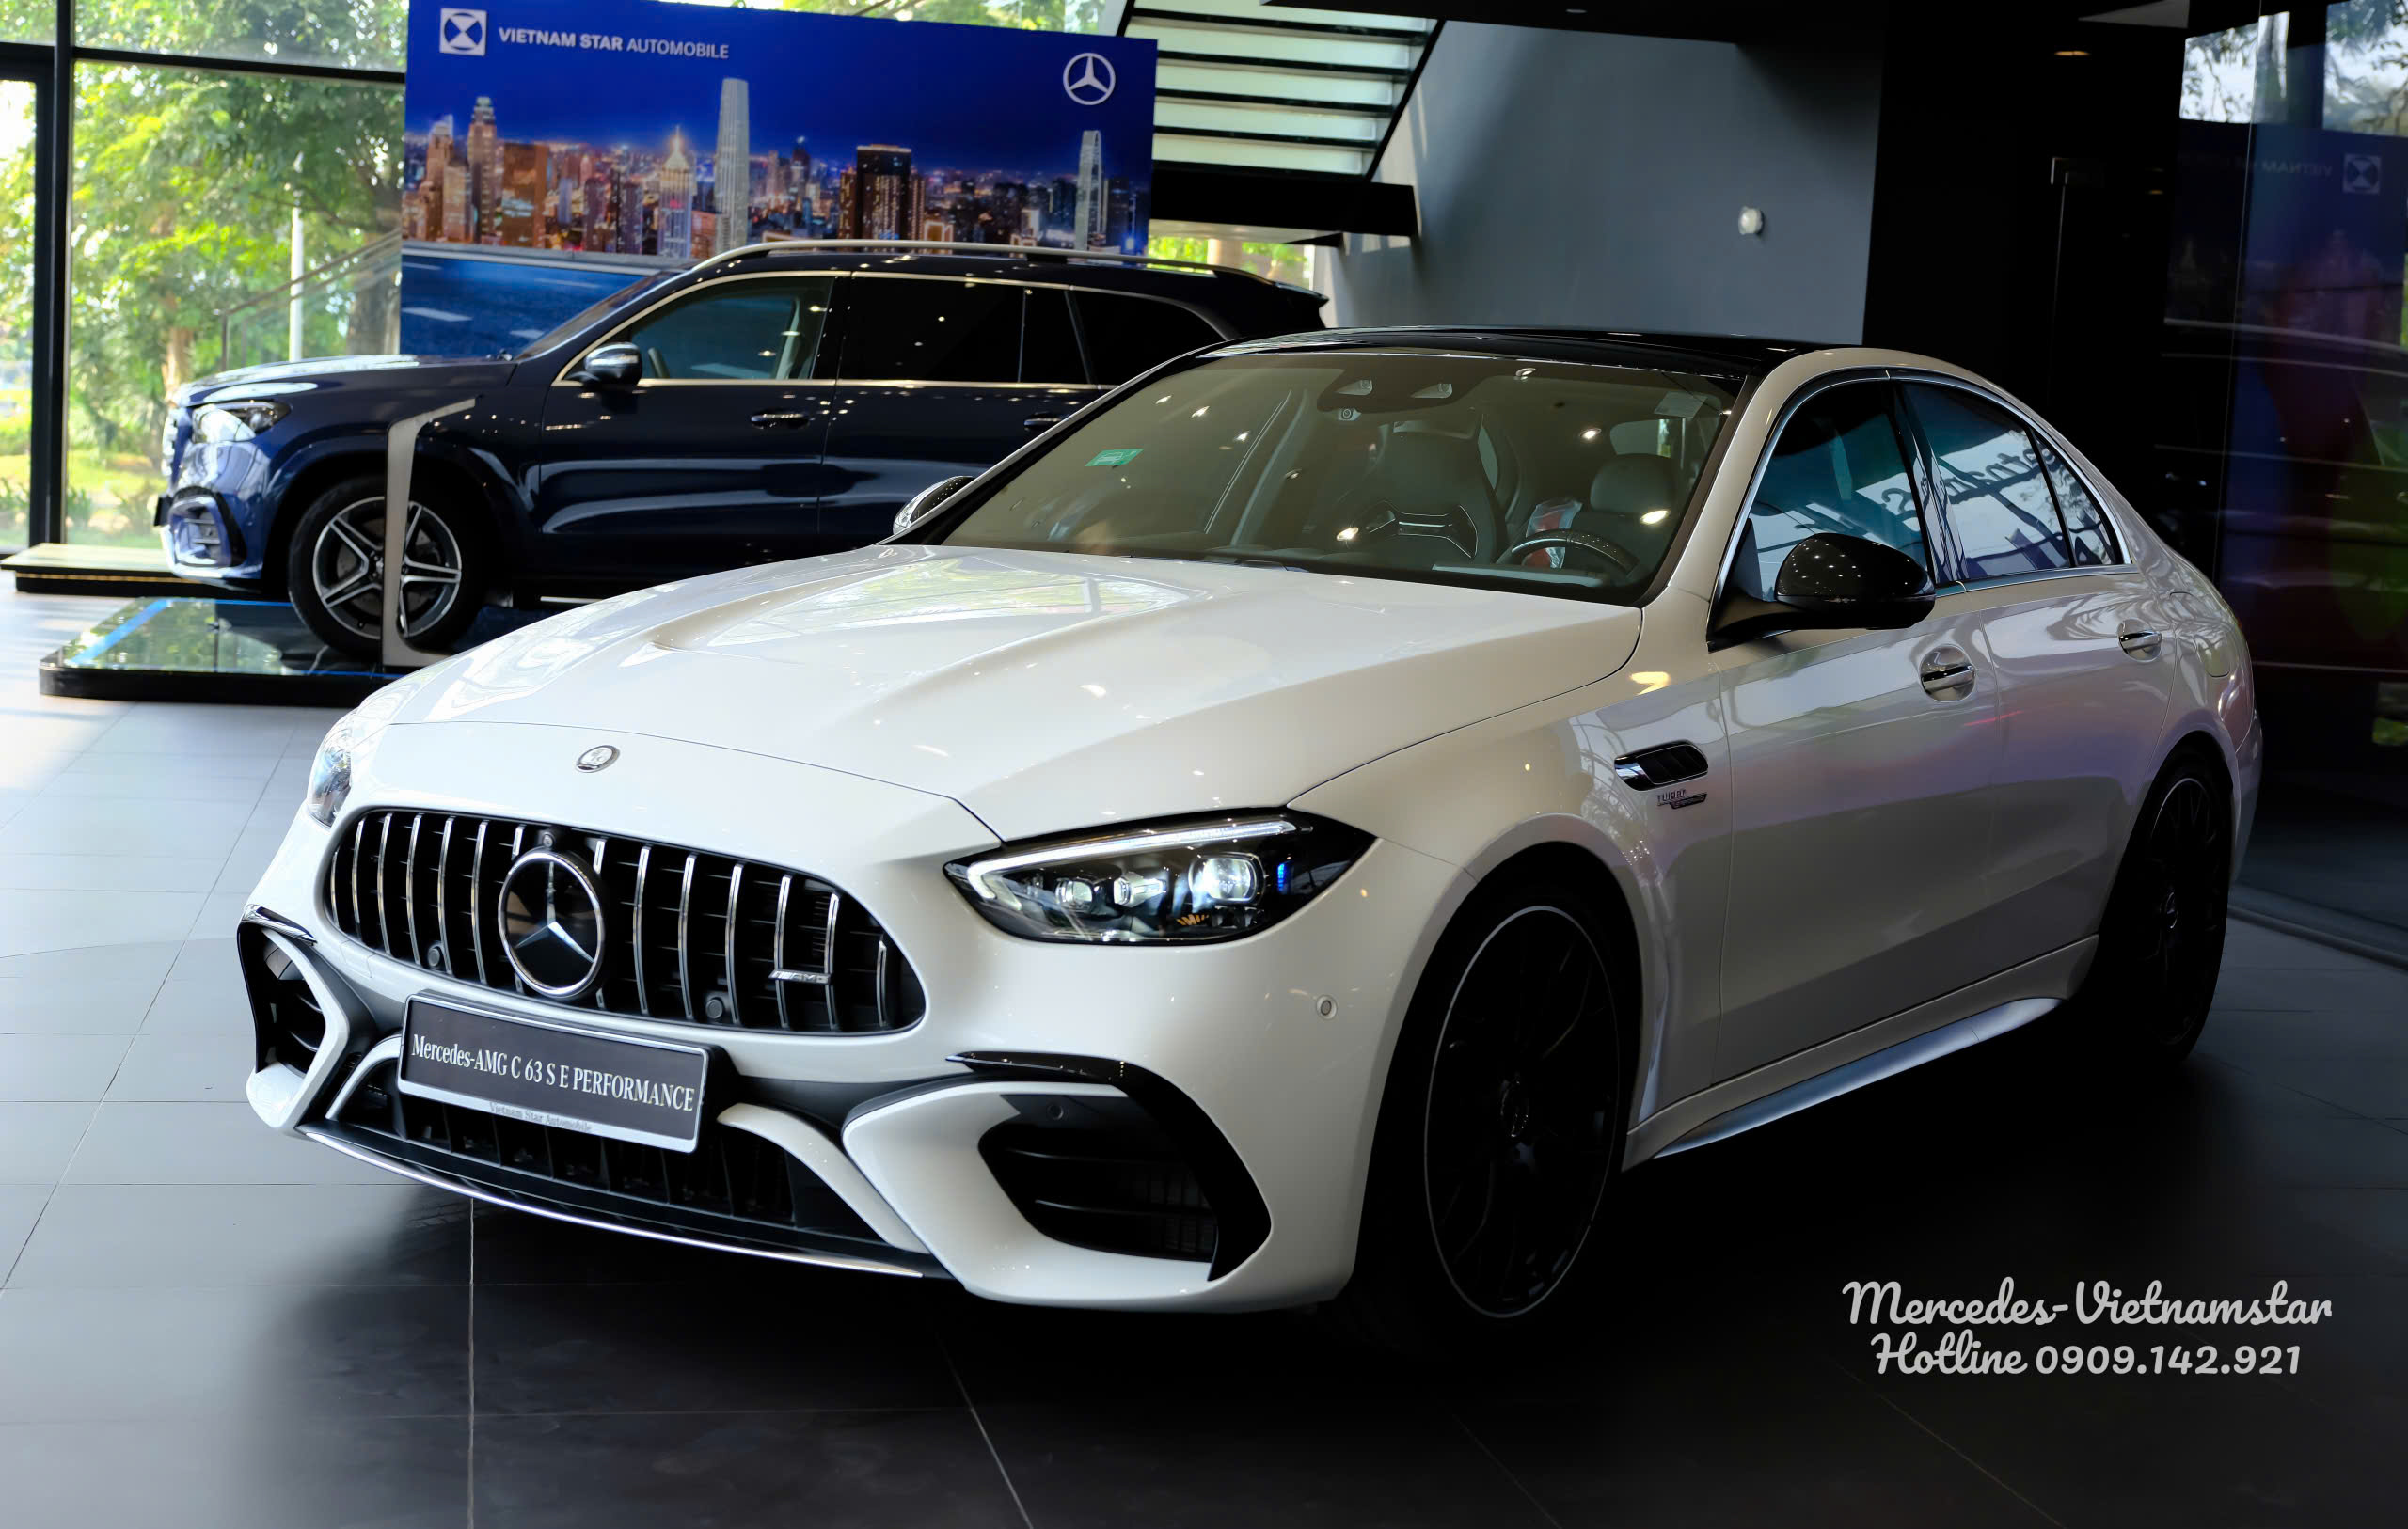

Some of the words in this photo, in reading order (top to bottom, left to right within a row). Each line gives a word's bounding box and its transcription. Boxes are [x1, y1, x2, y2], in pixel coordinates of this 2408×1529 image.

[499, 27, 576, 47] VIETNAM
[579, 34, 623, 51] STAR
[626, 38, 730, 59] AUTOMOBILE
[411, 1033, 508, 1076] Mercedes-AMG
[511, 1055, 522, 1079] C
[525, 1060, 543, 1083] 63
[547, 1063, 556, 1086] S
[560, 1065, 570, 1089] E
[573, 1067, 695, 1111] PERFORMANCE
